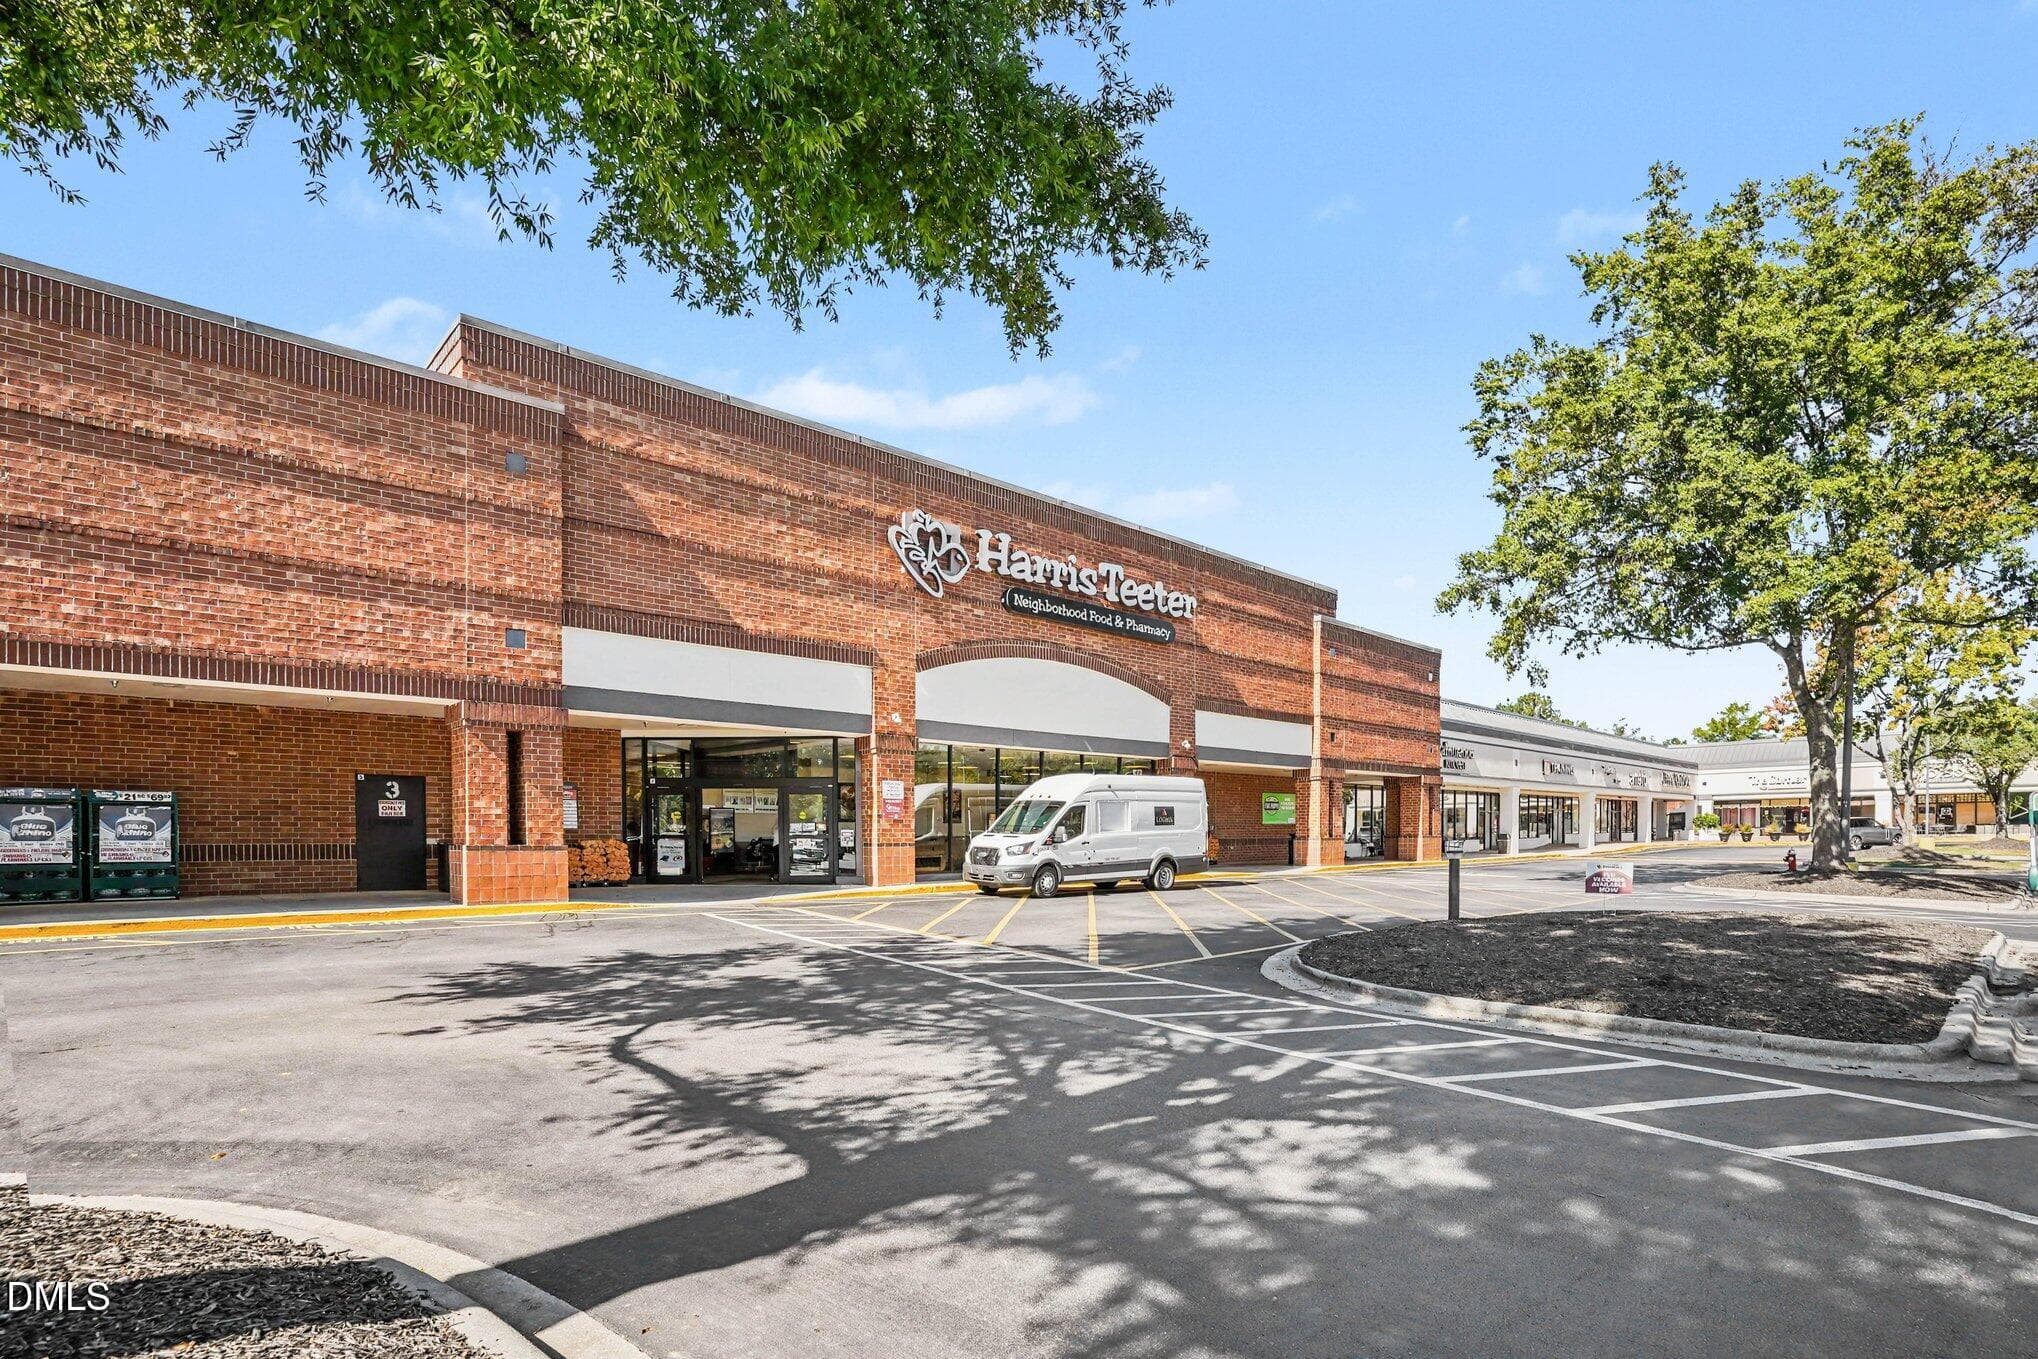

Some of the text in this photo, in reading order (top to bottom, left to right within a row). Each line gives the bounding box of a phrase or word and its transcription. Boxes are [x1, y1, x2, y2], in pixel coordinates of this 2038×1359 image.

[974, 528, 1198, 619] Harris Teeter
[1013, 593, 1172, 641] Neighborhood Food & Pharmacy
[385, 781, 400, 799] 3
